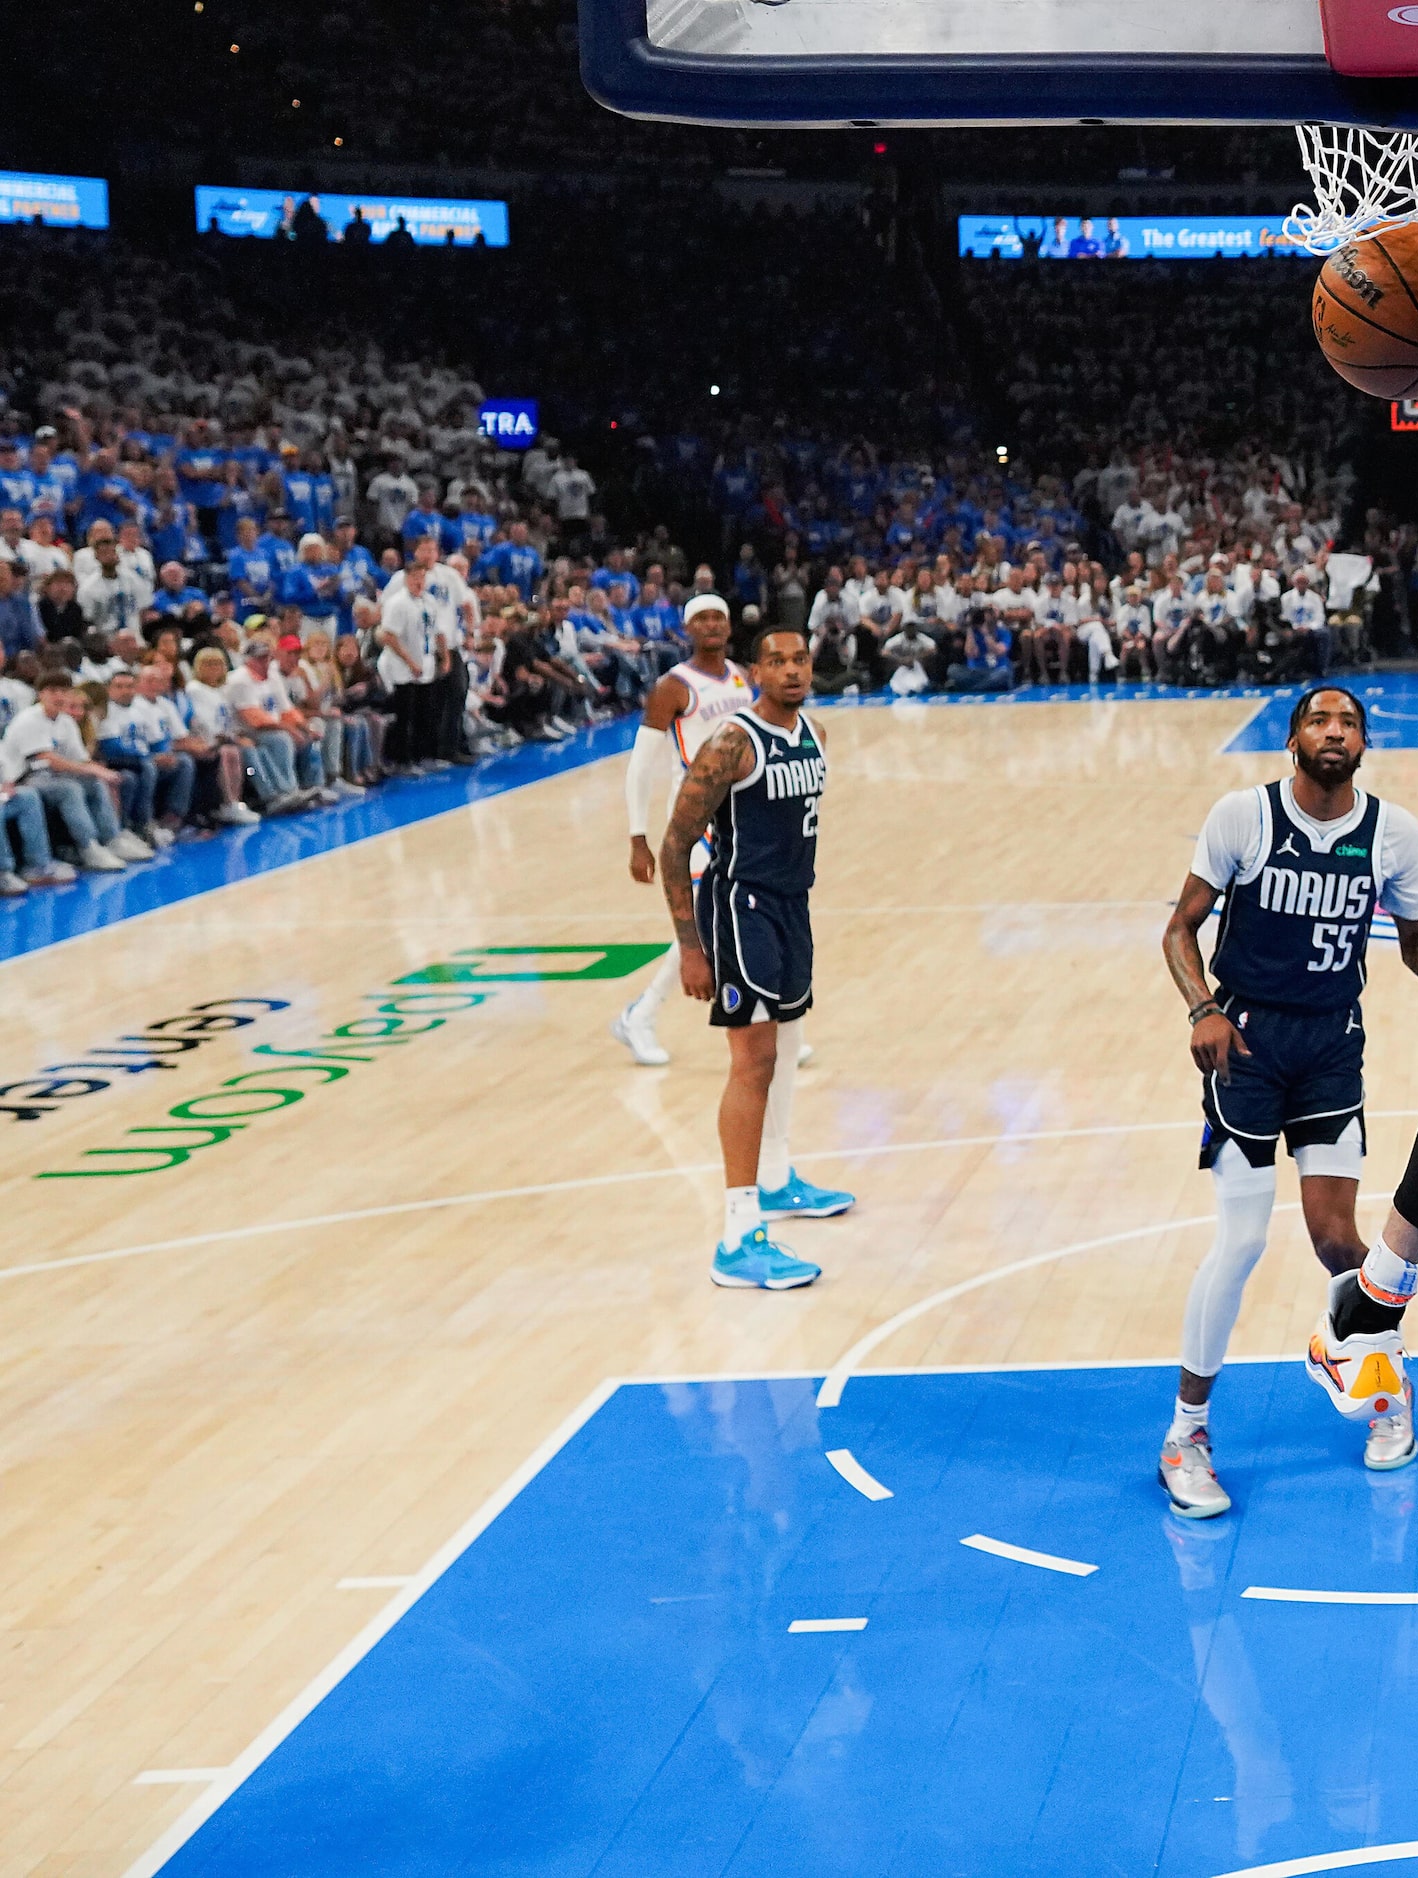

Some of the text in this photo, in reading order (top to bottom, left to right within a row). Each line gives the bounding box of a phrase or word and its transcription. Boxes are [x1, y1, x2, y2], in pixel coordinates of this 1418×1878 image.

[1142, 228, 1167, 248] The
[1177, 228, 1253, 248] Greatest
[477, 411, 536, 435] TRA
[1306, 922, 1360, 973] 55
[33, 991, 498, 1179] paycom
